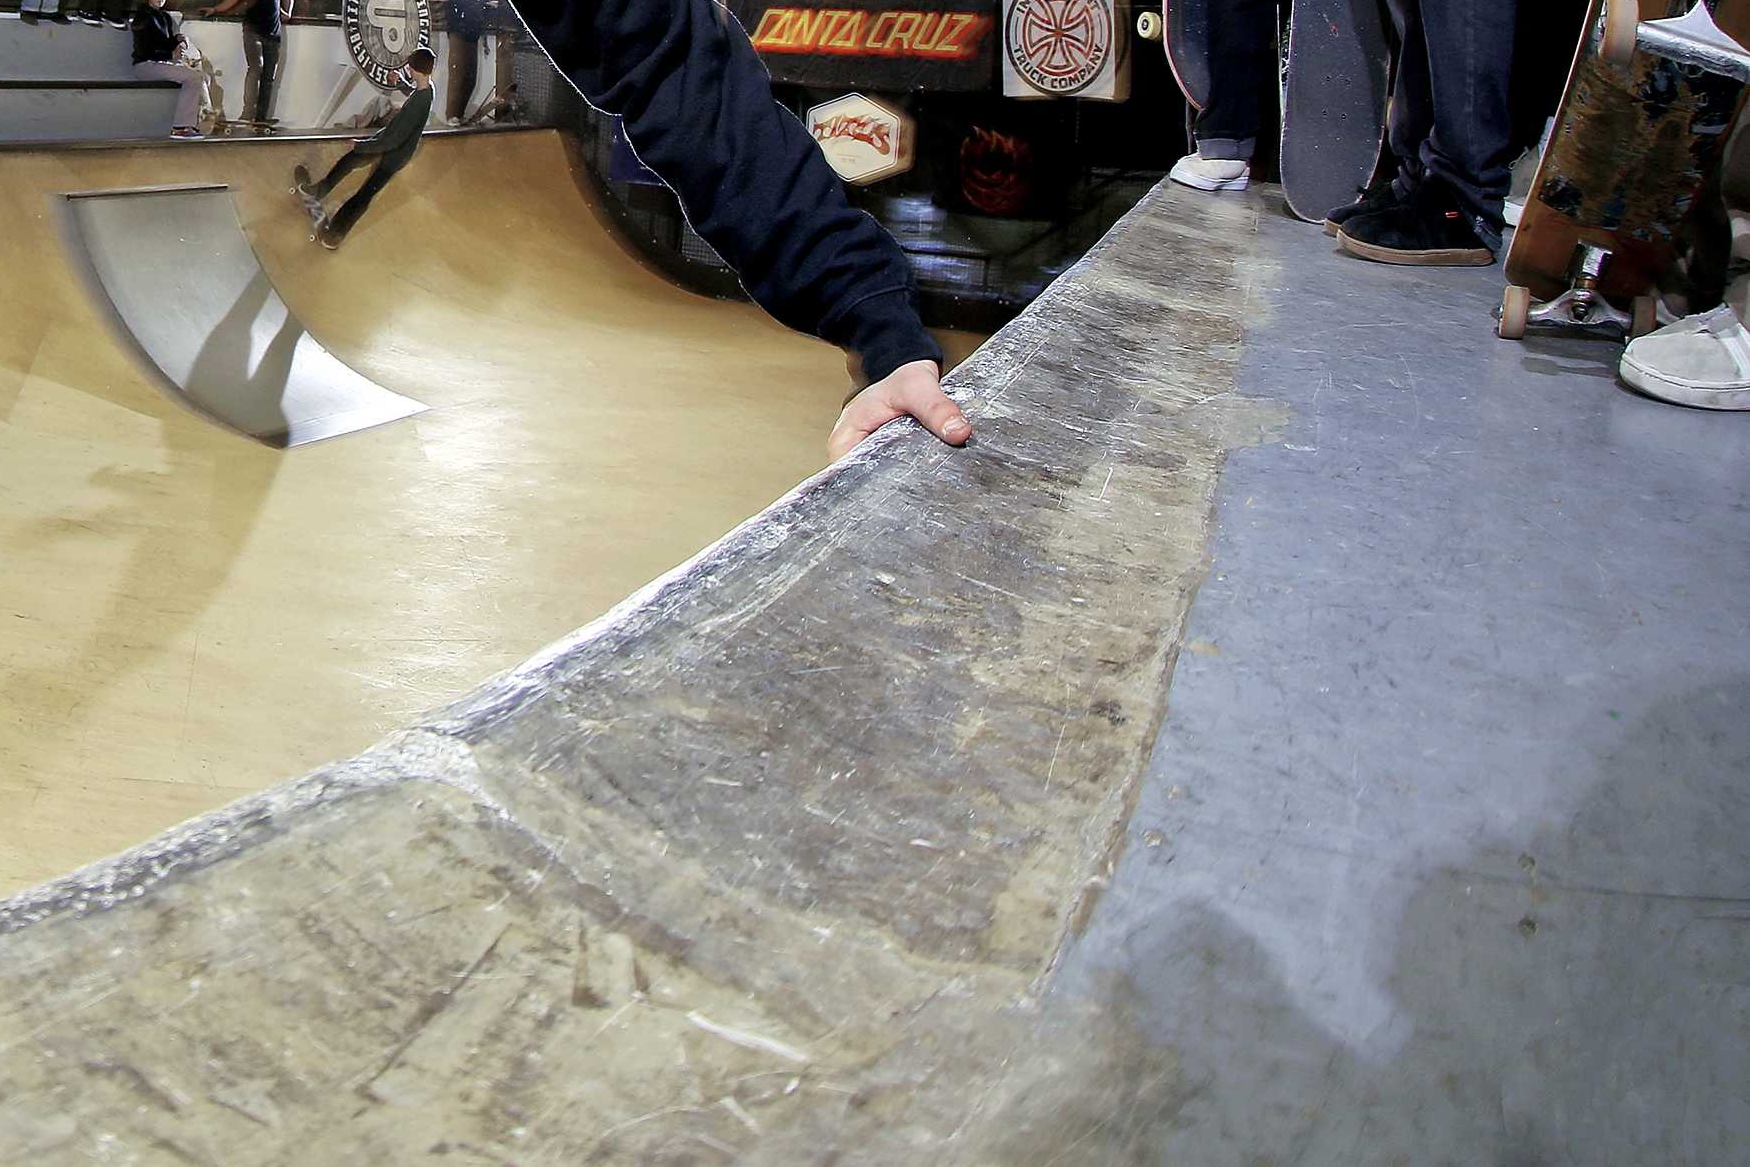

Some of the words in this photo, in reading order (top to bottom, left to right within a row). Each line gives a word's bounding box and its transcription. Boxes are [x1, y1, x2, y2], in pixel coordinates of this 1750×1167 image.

[751, 7, 863, 49] SANTA
[866, 11, 974, 52] CRUZ
[1014, 44, 1048, 85] TRUCK
[1051, 43, 1104, 89] COMPANY
